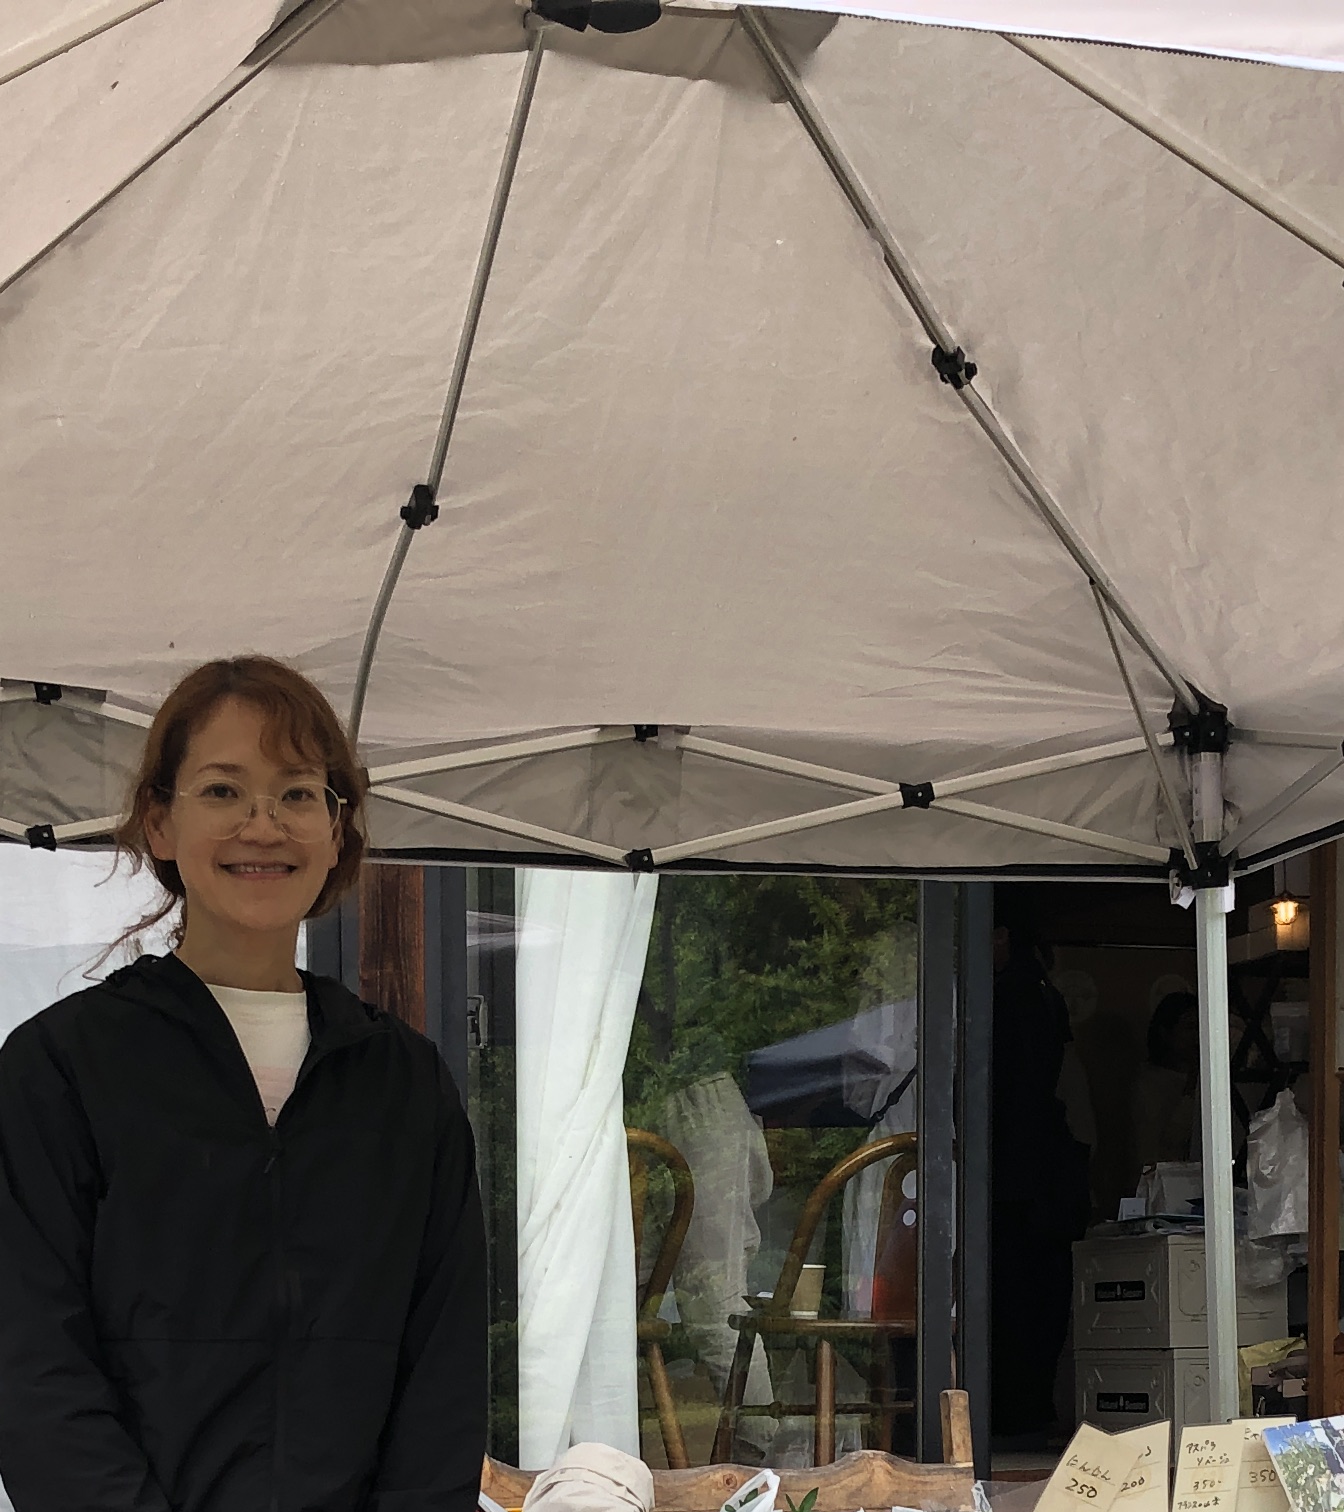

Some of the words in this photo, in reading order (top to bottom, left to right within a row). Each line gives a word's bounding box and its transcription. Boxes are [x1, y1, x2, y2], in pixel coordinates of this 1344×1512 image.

[1065, 1453, 1112, 1482] にんじん
[1249, 1469, 1277, 1483] 350
[1065, 1478, 1098, 1498] 250
[1120, 1476, 1145, 1492] 200
